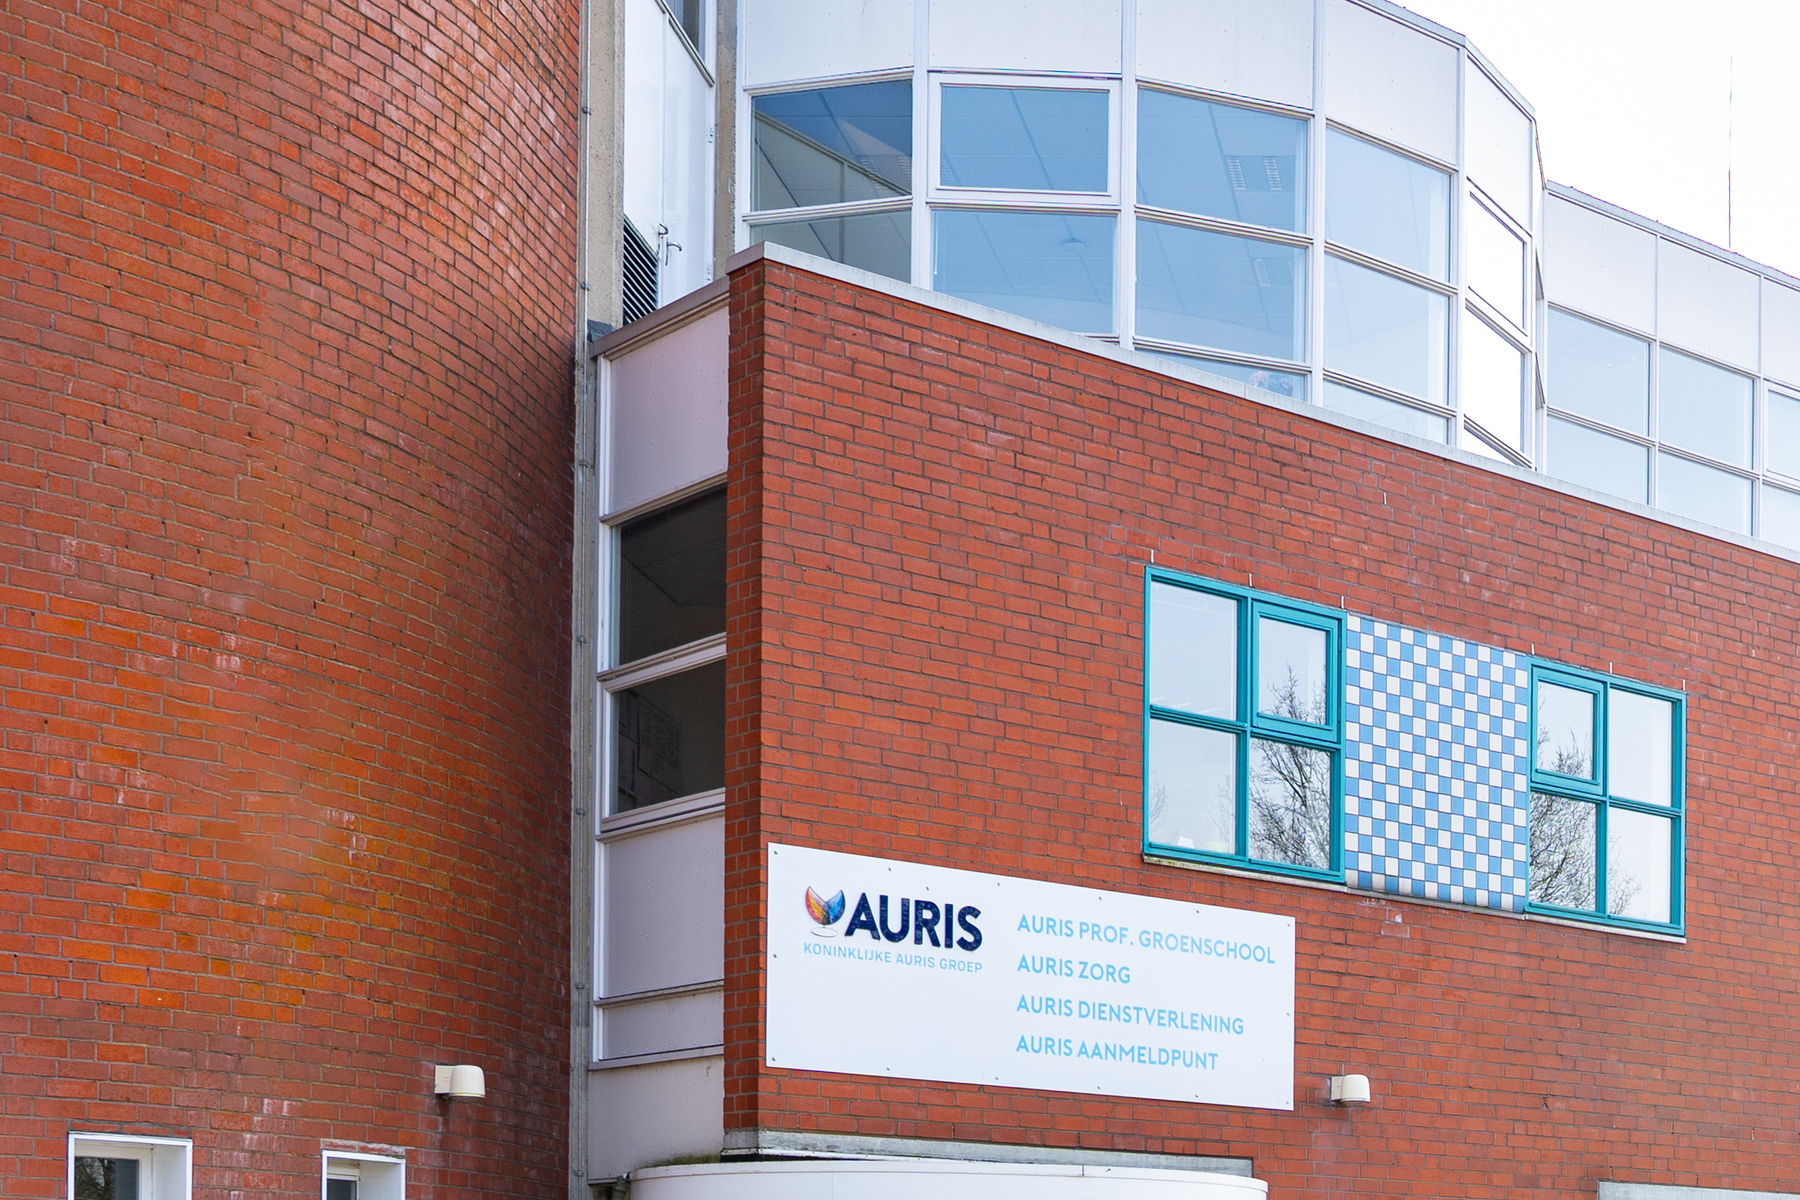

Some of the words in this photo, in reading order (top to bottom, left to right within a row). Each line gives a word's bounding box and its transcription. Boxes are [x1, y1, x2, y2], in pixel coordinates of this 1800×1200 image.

[844, 891, 984, 952] AURIS
[1016, 914, 1075, 938] AURIS
[1079, 921, 1135, 946] PROF.
[1138, 929, 1277, 965] GROENSCHOOL
[803, 942, 892, 964] KONINKLIJKE
[895, 953, 936, 969] AURIS
[939, 957, 983, 973] GROEP
[1016, 954, 1074, 978] AURIS
[1078, 960, 1131, 985] ZORG
[1016, 994, 1074, 1018] AURIS
[1078, 1000, 1244, 1036] DIENSTVERLENING
[1016, 1034, 1074, 1057] AURIS
[1077, 1040, 1219, 1071] AANMELDPUNT
